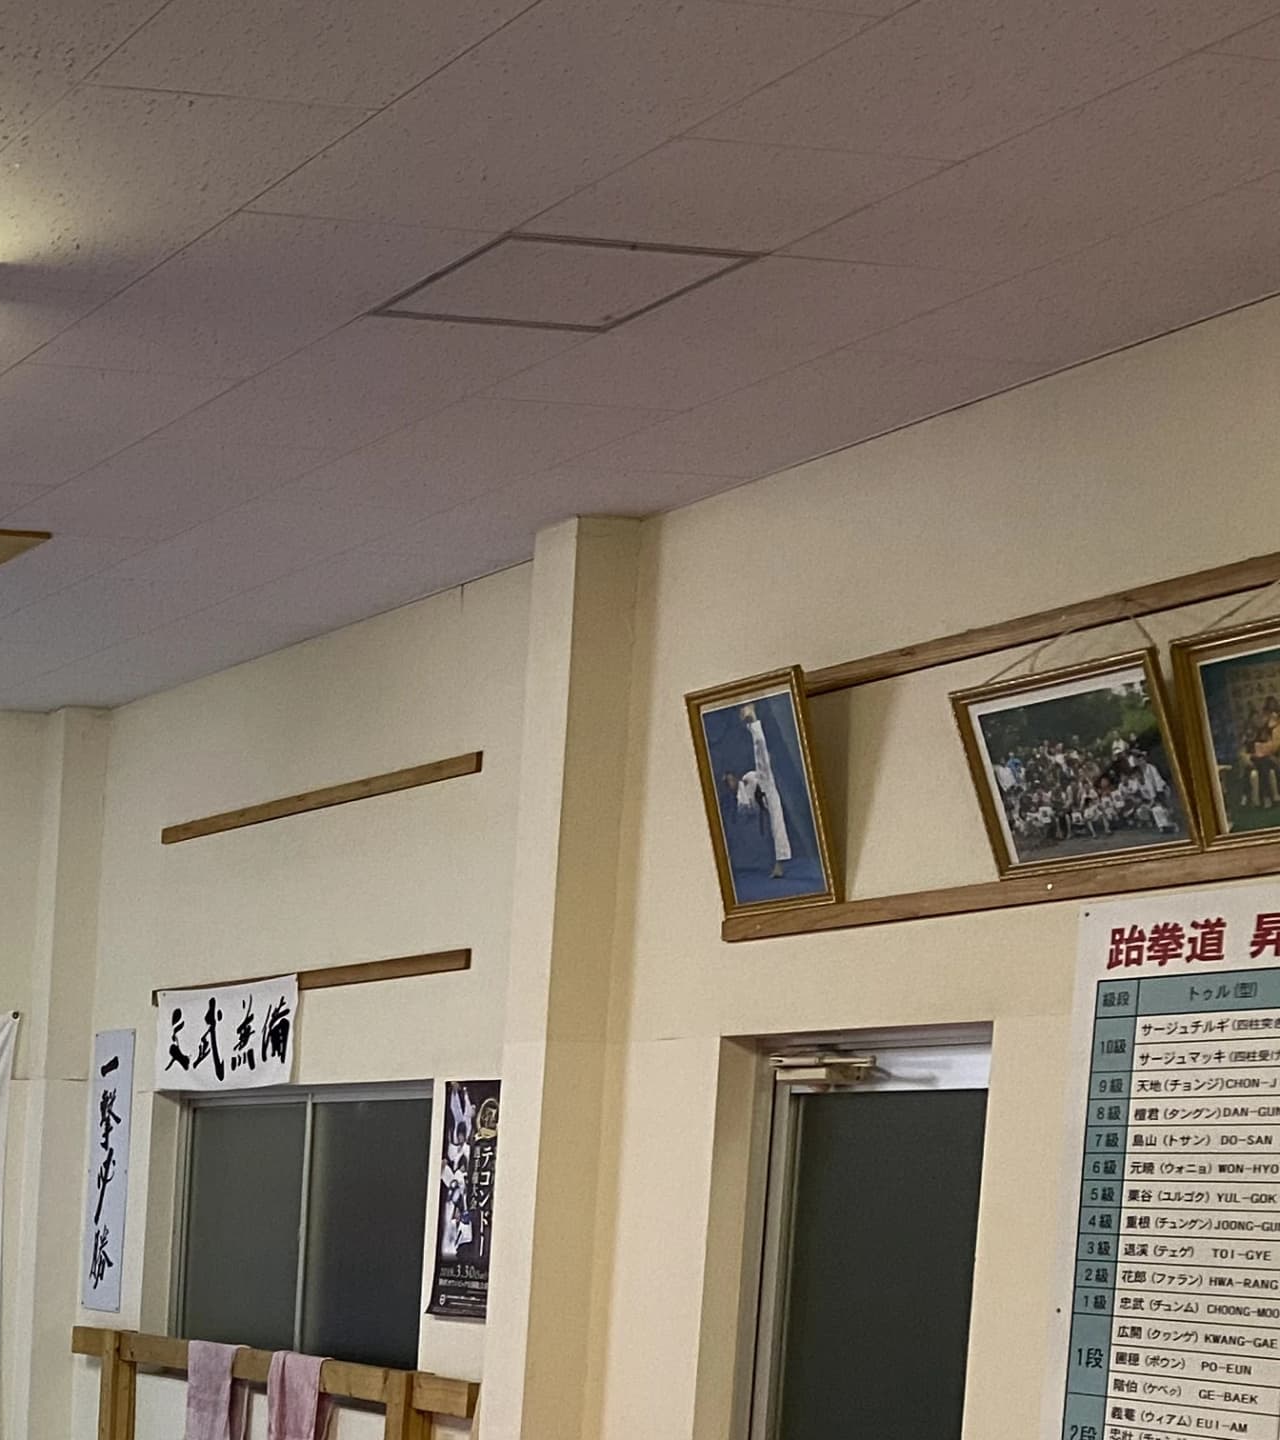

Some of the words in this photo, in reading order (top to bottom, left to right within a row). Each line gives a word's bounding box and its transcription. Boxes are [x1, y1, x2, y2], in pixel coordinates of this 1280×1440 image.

[1107, 917, 1227, 970] 跆拳道
[1225, 1078, 1277, 1089] CHON-J
[1220, 1135, 1273, 1145] DO-SAN
[1218, 1164, 1279, 1174] WON-HYO
[1217, 1193, 1277, 1204] YUL-GOK
[1212, 1248, 1272, 1261] TOI-GYE
[1209, 1277, 1278, 1290] HWA-RANG
[1207, 1304, 1280, 1319] CHOONG-MOO
[1204, 1334, 1278, 1349] KWANG-GAE
[1077, 1348, 1104, 1369] 1段
[1201, 1362, 1252, 1375] PO-EUN
[1199, 1389, 1259, 1405] GE-BAEK
[1196, 1418, 1248, 1433] EUI-AM
